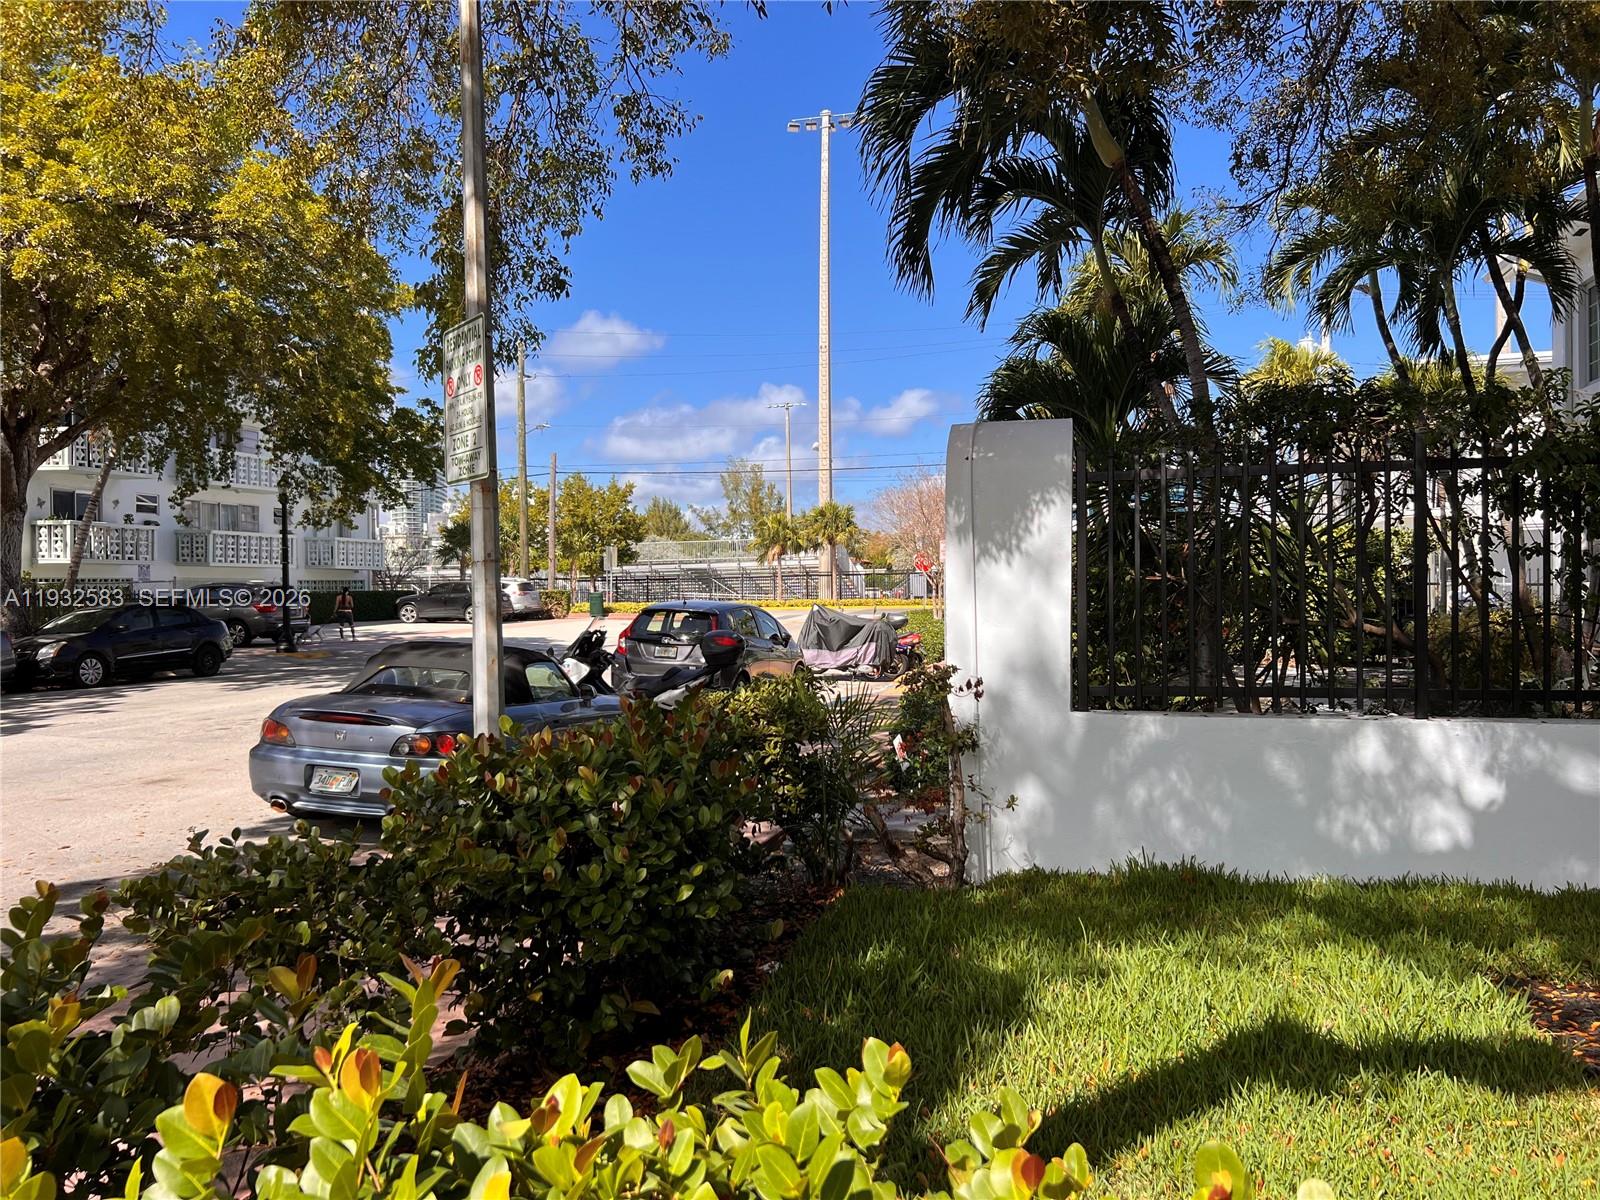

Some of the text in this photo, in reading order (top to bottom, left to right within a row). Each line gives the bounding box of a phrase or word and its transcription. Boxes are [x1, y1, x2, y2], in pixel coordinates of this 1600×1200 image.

[446, 323, 481, 353] RESIDENTIAL
[457, 371, 472, 390] ONLY
[452, 432, 477, 452] ZONE 2
[451, 450, 481, 467] TOW-AWAY
[458, 464, 475, 477] ZONE
